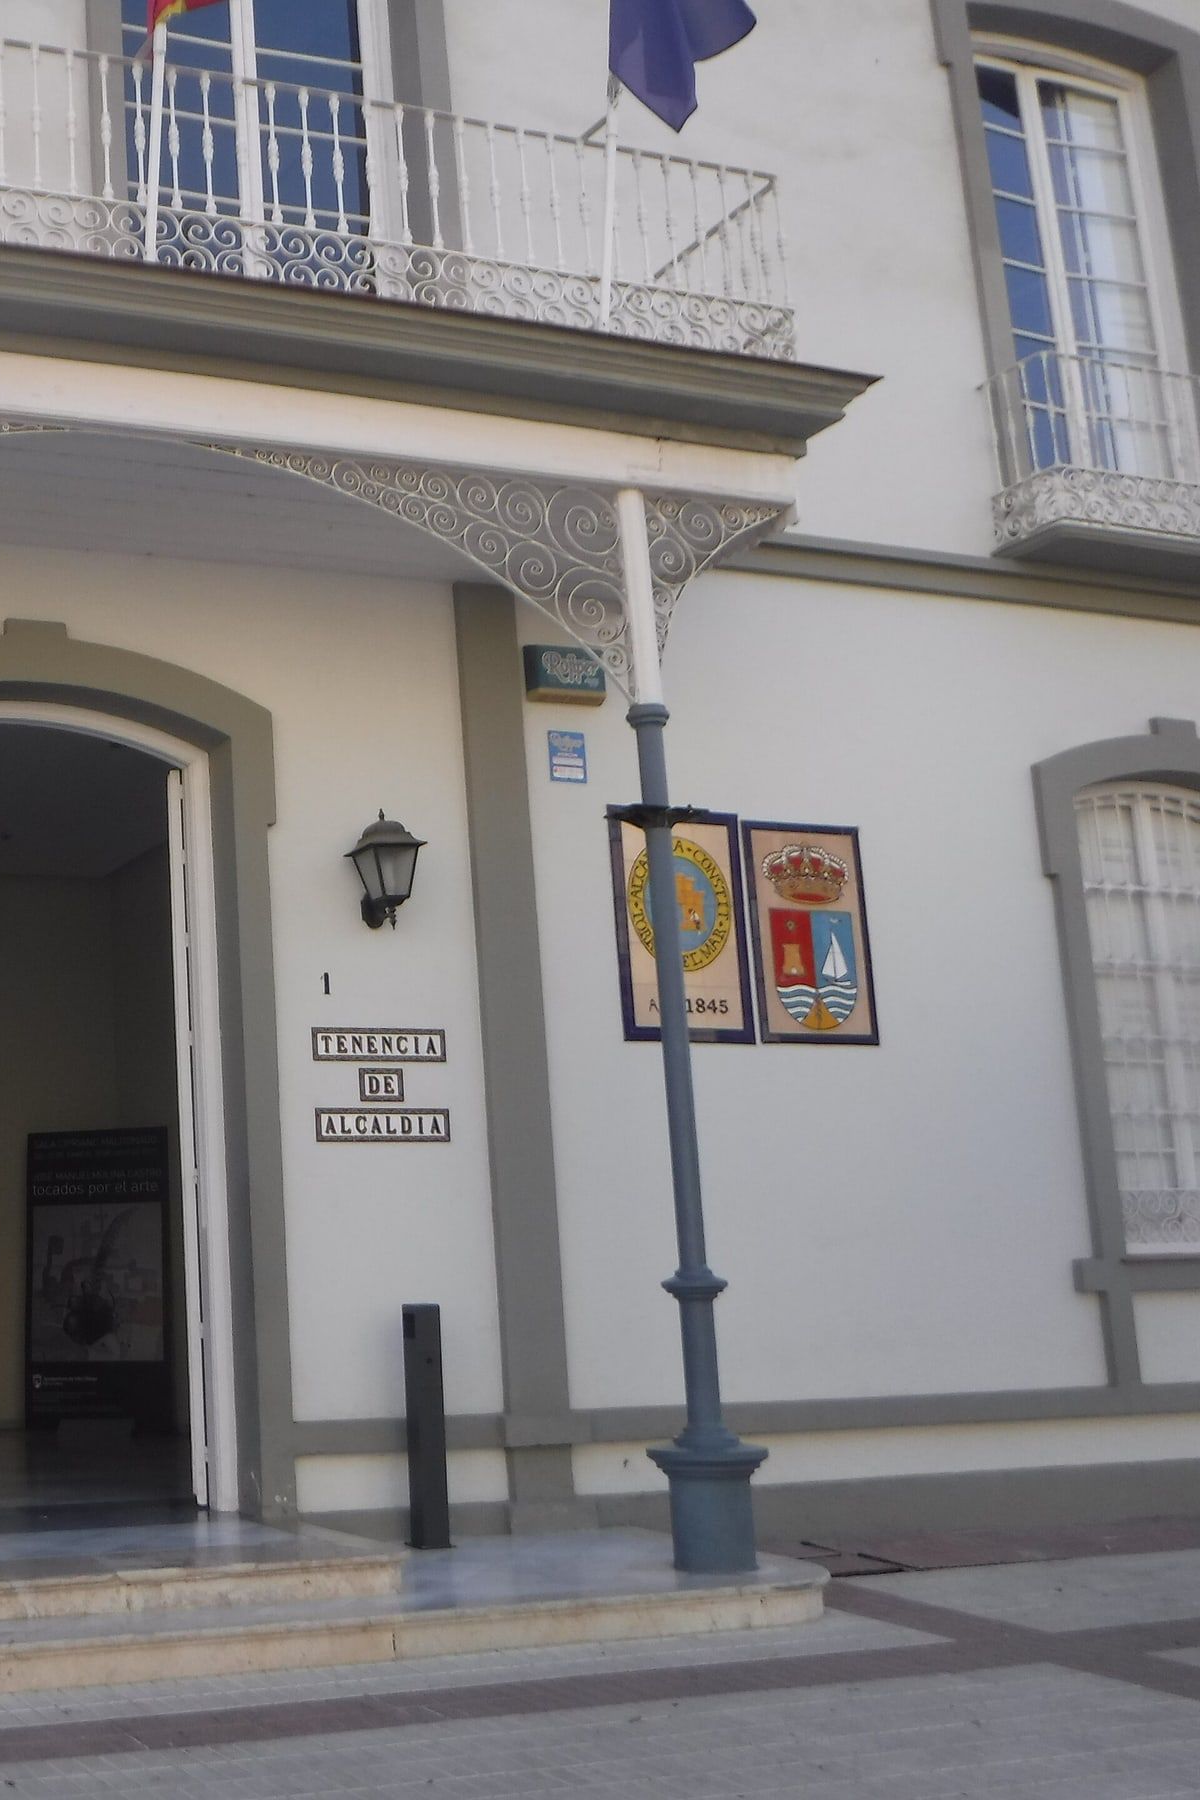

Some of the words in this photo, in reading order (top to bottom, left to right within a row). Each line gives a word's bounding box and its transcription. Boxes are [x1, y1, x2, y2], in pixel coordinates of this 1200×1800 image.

[699, 928, 727, 959] MAR
[321, 972, 331, 995] 1
[685, 997, 729, 1014] 1845
[321, 1035, 438, 1055] TENENCIA
[367, 1075, 395, 1095] DE
[325, 1115, 442, 1135] ALCALDIA
[32, 1181, 84, 1196] tocados
[88, 1182, 110, 1198] por
[114, 1180, 127, 1193] el
[130, 1180, 159, 1193] arte
